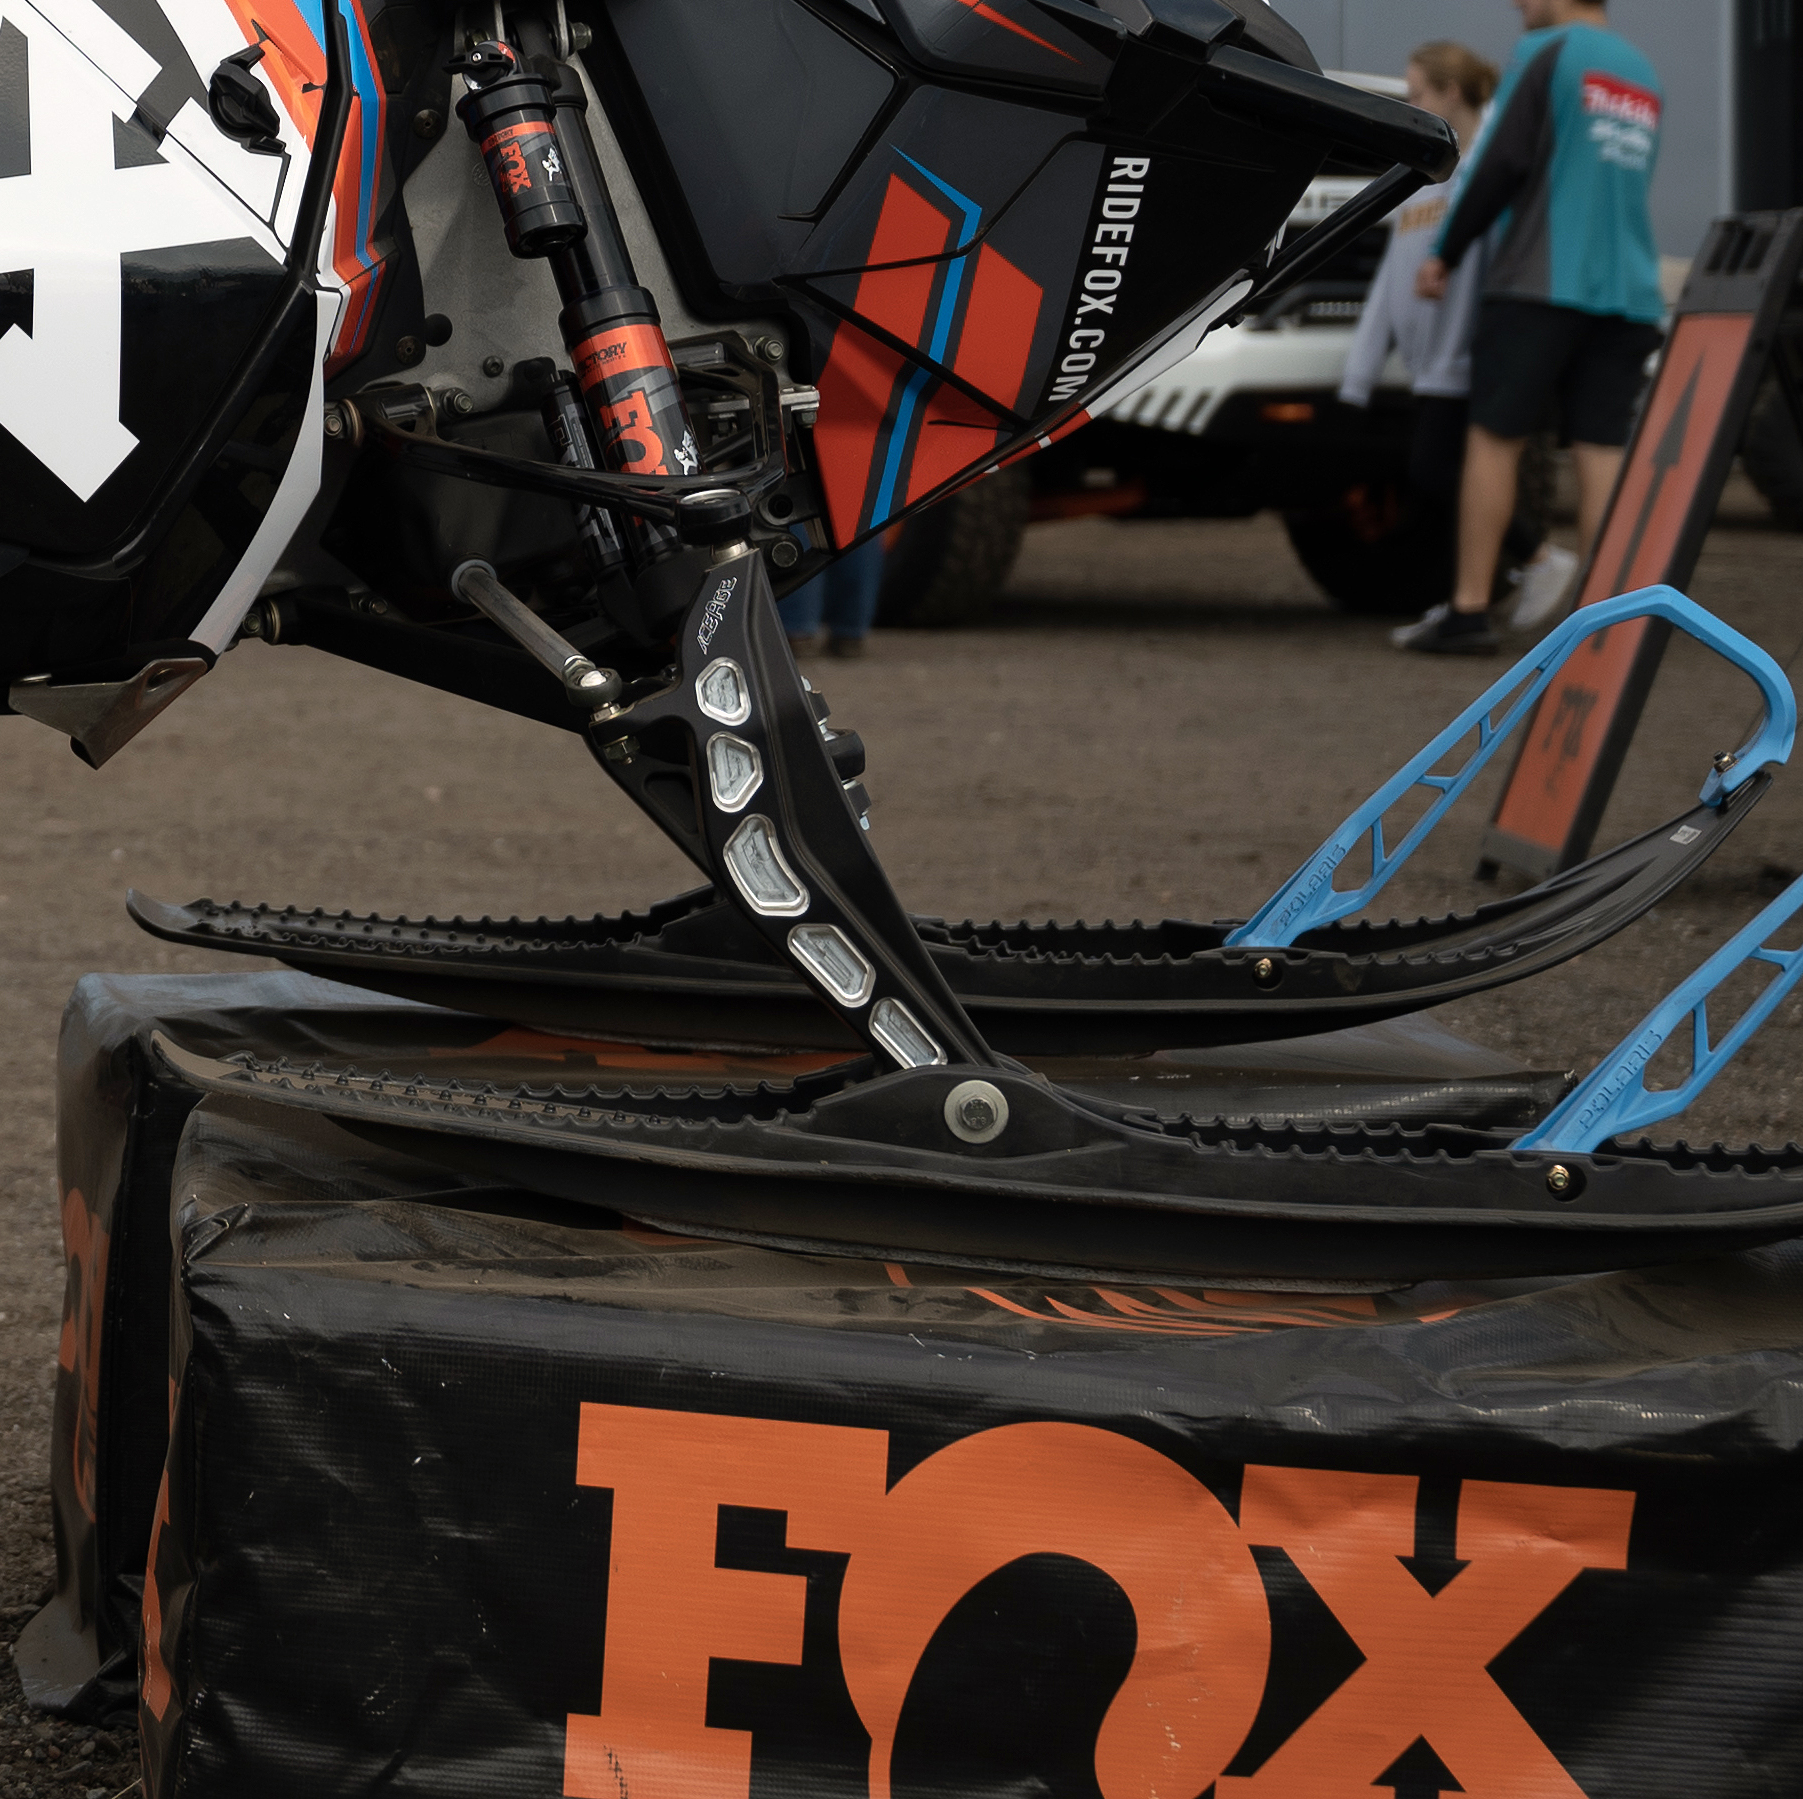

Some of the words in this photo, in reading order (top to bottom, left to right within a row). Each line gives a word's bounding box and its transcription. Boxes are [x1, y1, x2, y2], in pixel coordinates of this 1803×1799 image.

[497, 141, 533, 195] FOX
[1048, 156, 1151, 402] RIDEFOX.COM
[599, 389, 670, 476] FO
[697, 576, 738, 655] ICEAGE
[1279, 843, 1346, 927] POLARIS
[563, 1400, 1637, 1799] FOX
